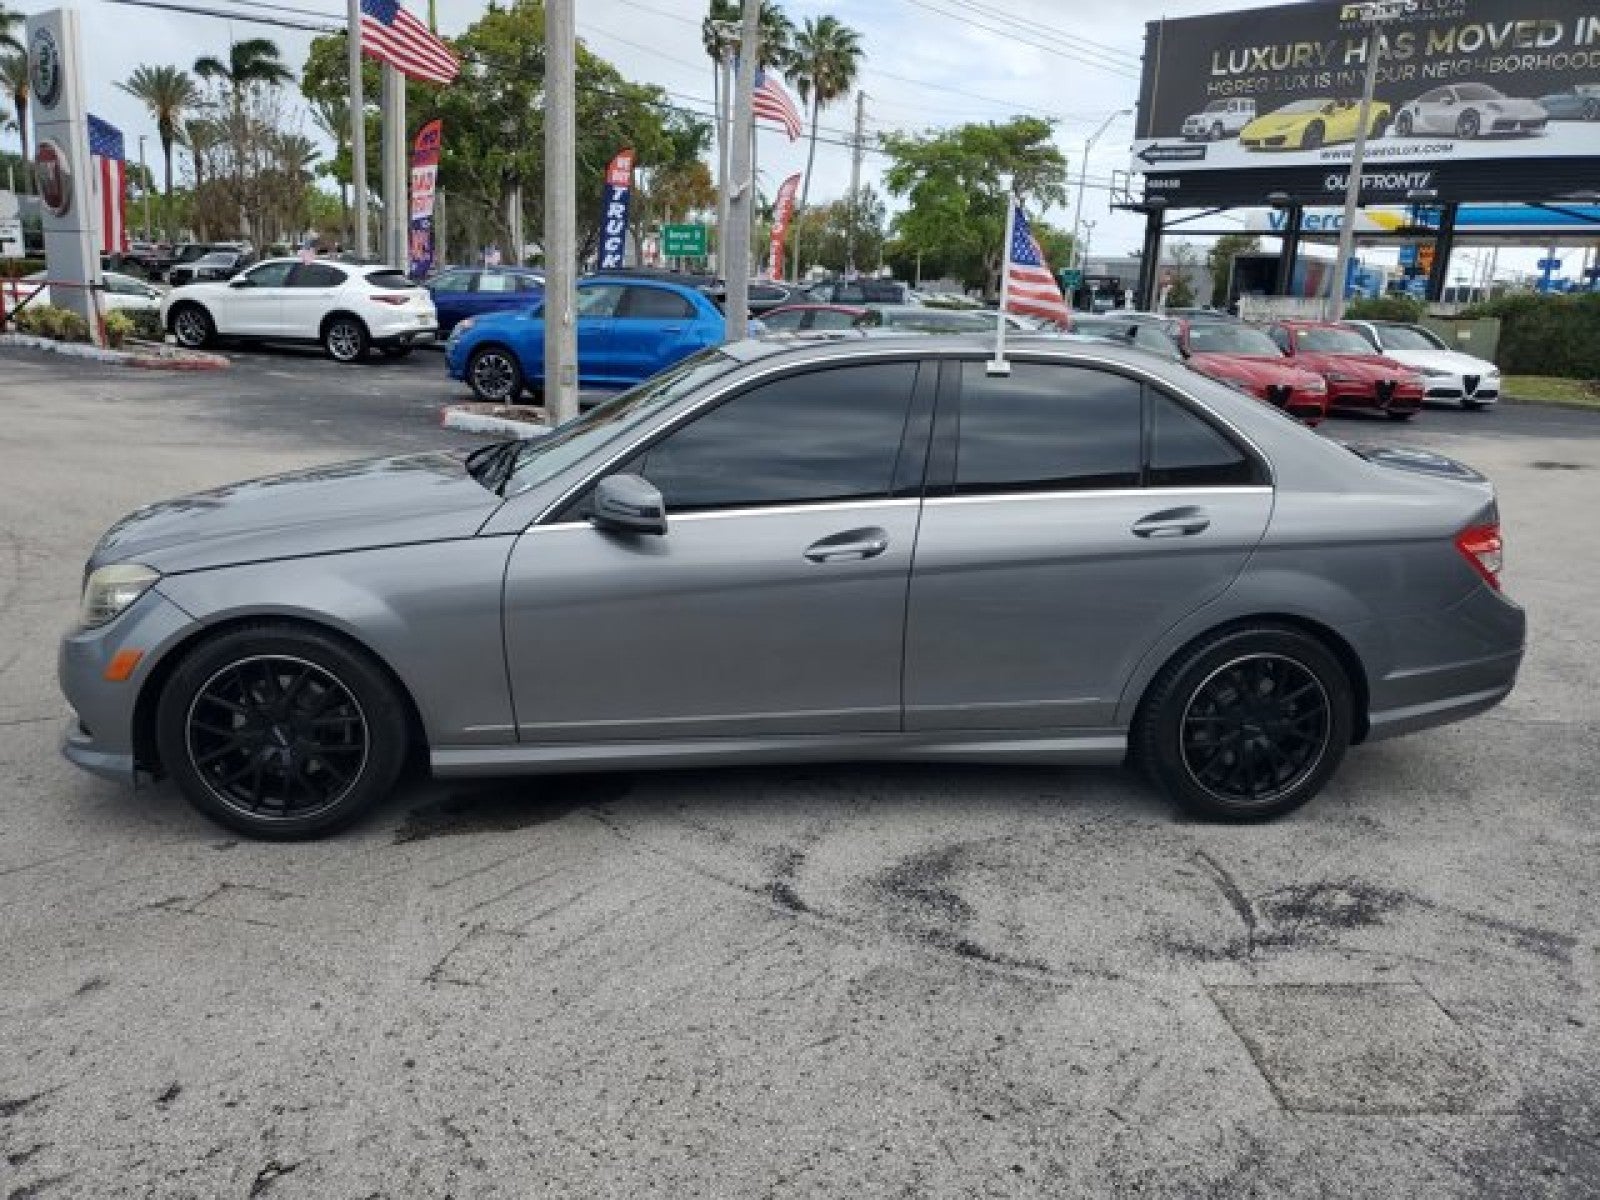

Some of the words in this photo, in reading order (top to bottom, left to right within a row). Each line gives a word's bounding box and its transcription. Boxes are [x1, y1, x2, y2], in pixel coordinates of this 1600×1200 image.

[1211, 40, 1337, 76] LUXURY
[1344, 31, 1416, 66] HAS
[1424, 19, 1564, 56] MOVED
[1315, 72, 1331, 88] IS
[602, 185, 629, 268] TRUCK
